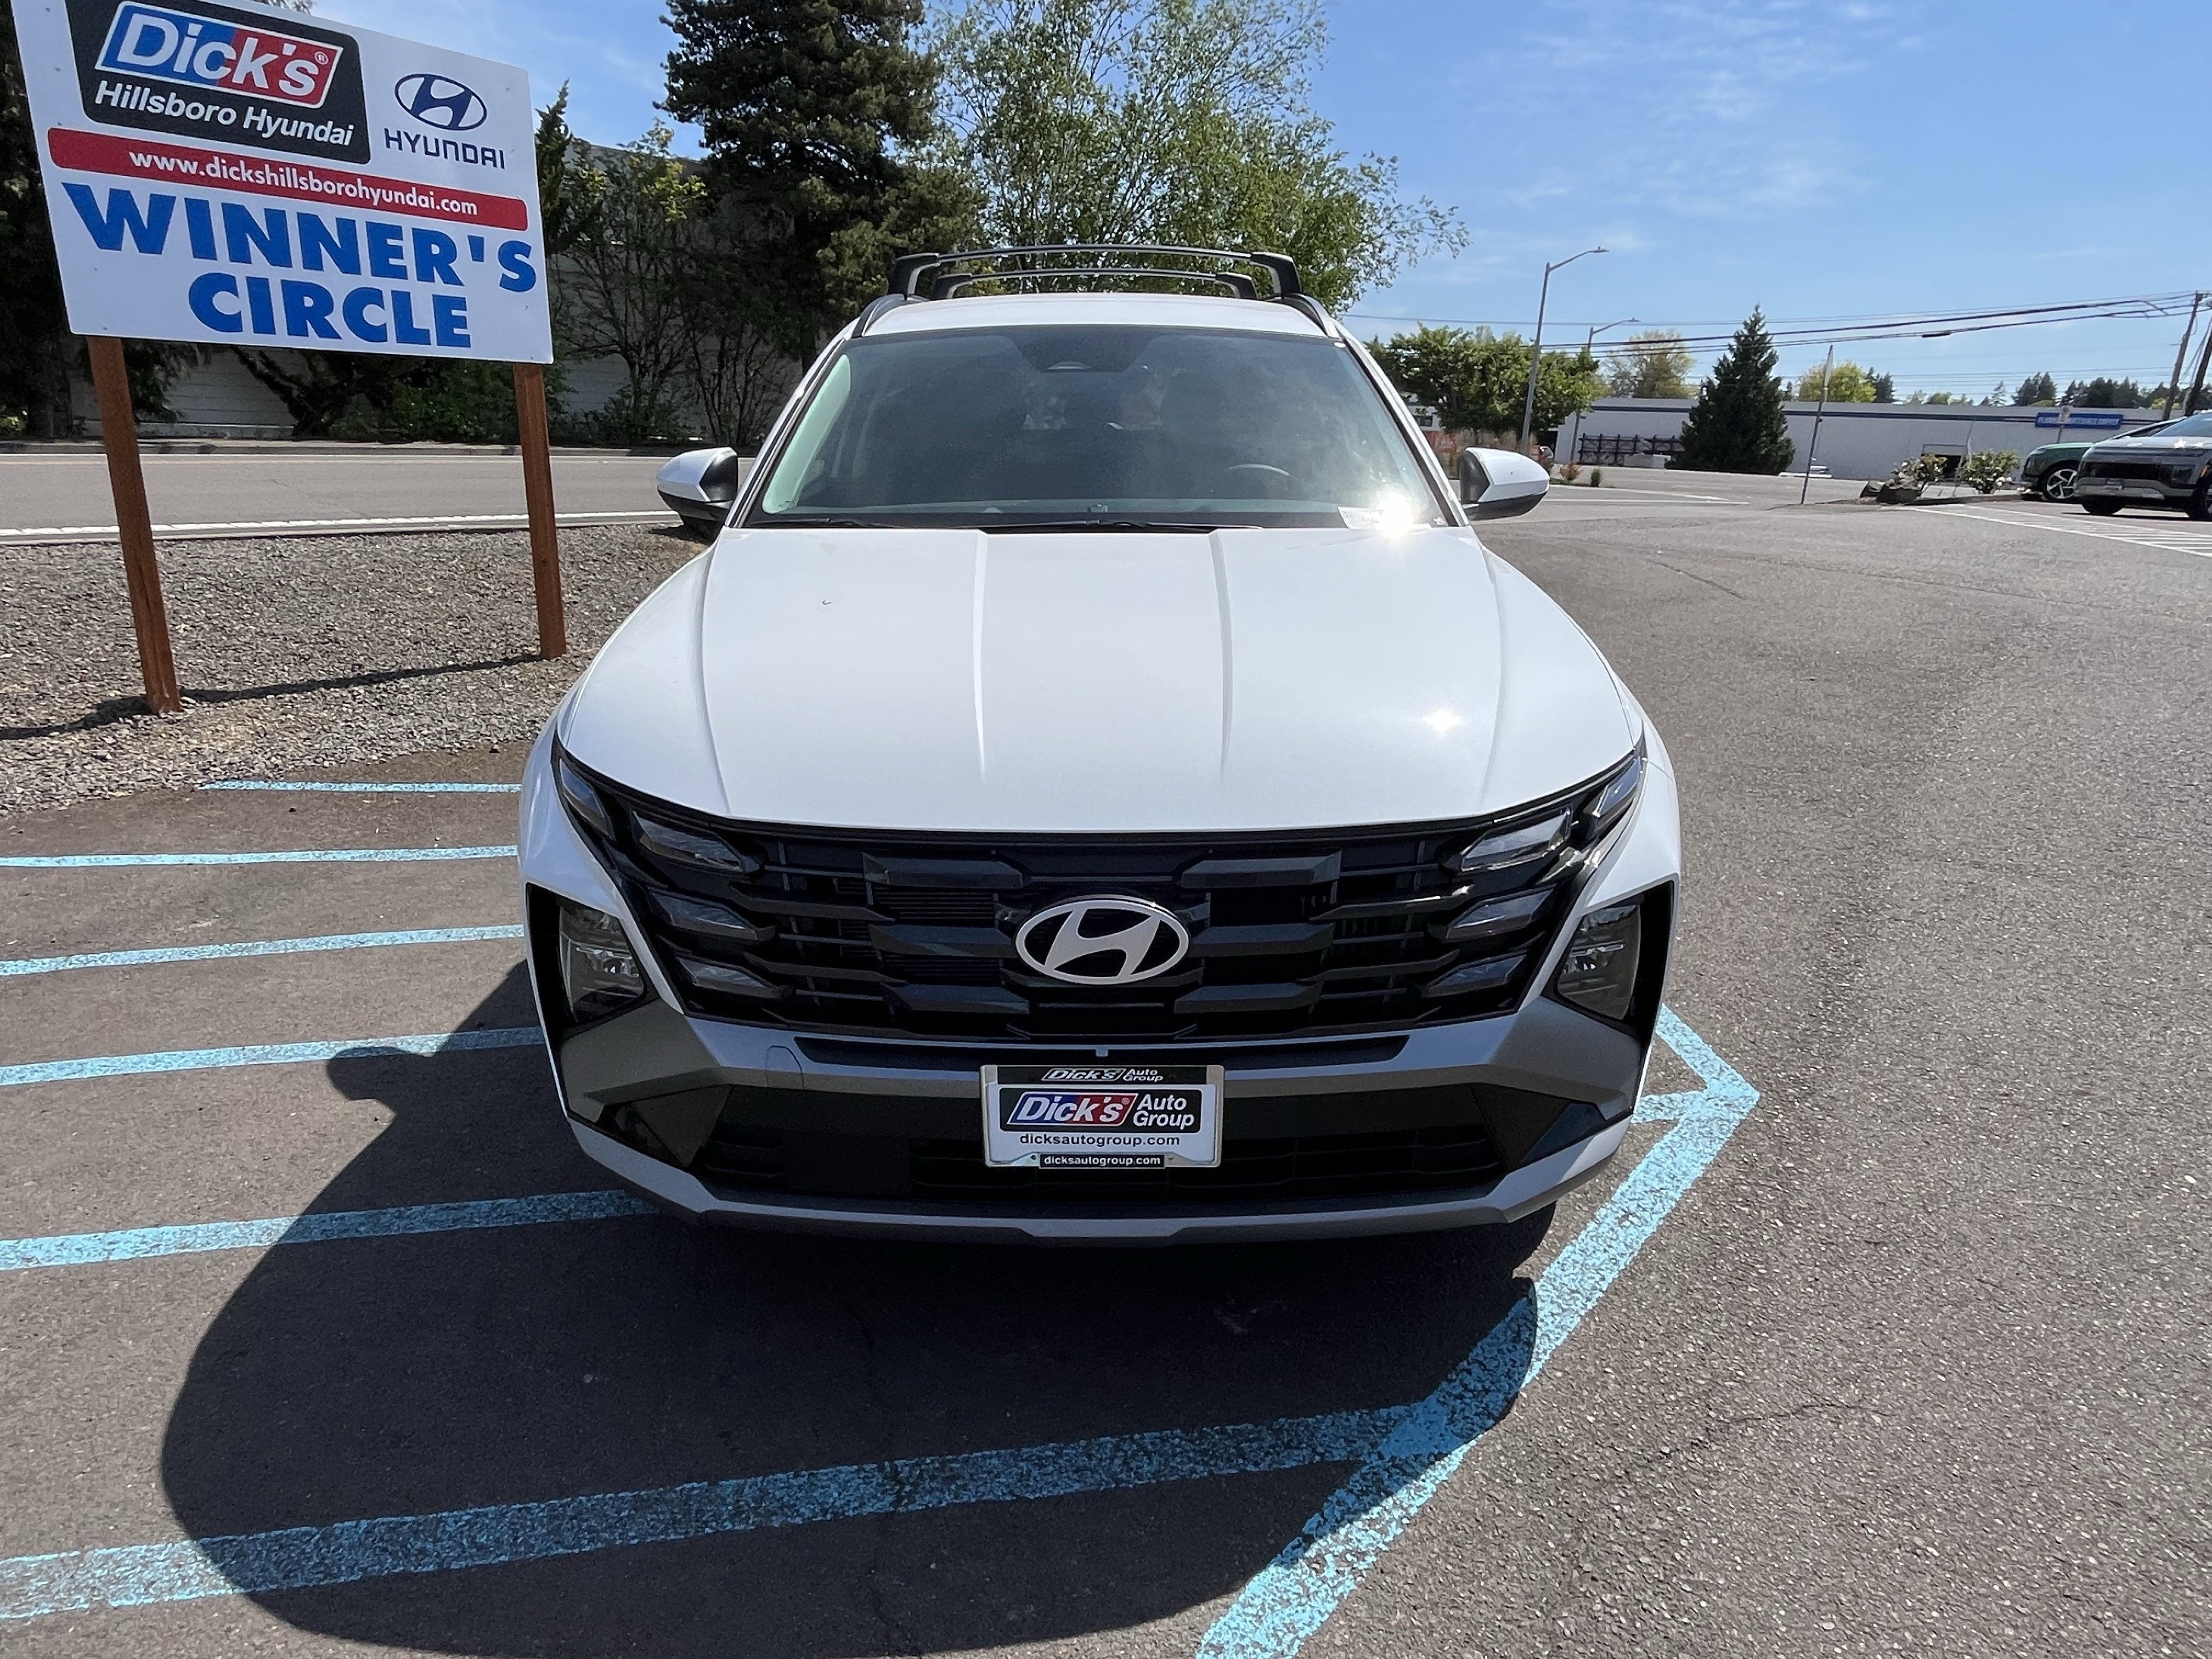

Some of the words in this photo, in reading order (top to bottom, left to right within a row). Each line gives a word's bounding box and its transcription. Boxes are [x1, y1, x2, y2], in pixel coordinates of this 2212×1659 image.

[116, 11, 320, 97] Dick's
[94, 80, 236, 126] Hillsboro
[243, 106, 354, 148] Hyundai
[383, 128, 505, 170] HYUNDAI
[129, 151, 478, 217] www.dickshillsborohyundai.com
[61, 182, 537, 293] WINNER'S
[189, 272, 471, 348] CIRCLE
[1047, 1069, 1116, 1080] Dick's
[1122, 1074, 1164, 1082] Group
[1016, 1096, 1123, 1122] Dick's
[1137, 1094, 1186, 1111] Auto
[1133, 1111, 1195, 1130] Group
[1020, 1133, 1180, 1147] dicksautogroup.com
[1044, 1156, 1161, 1166] dicksautogroup.com
